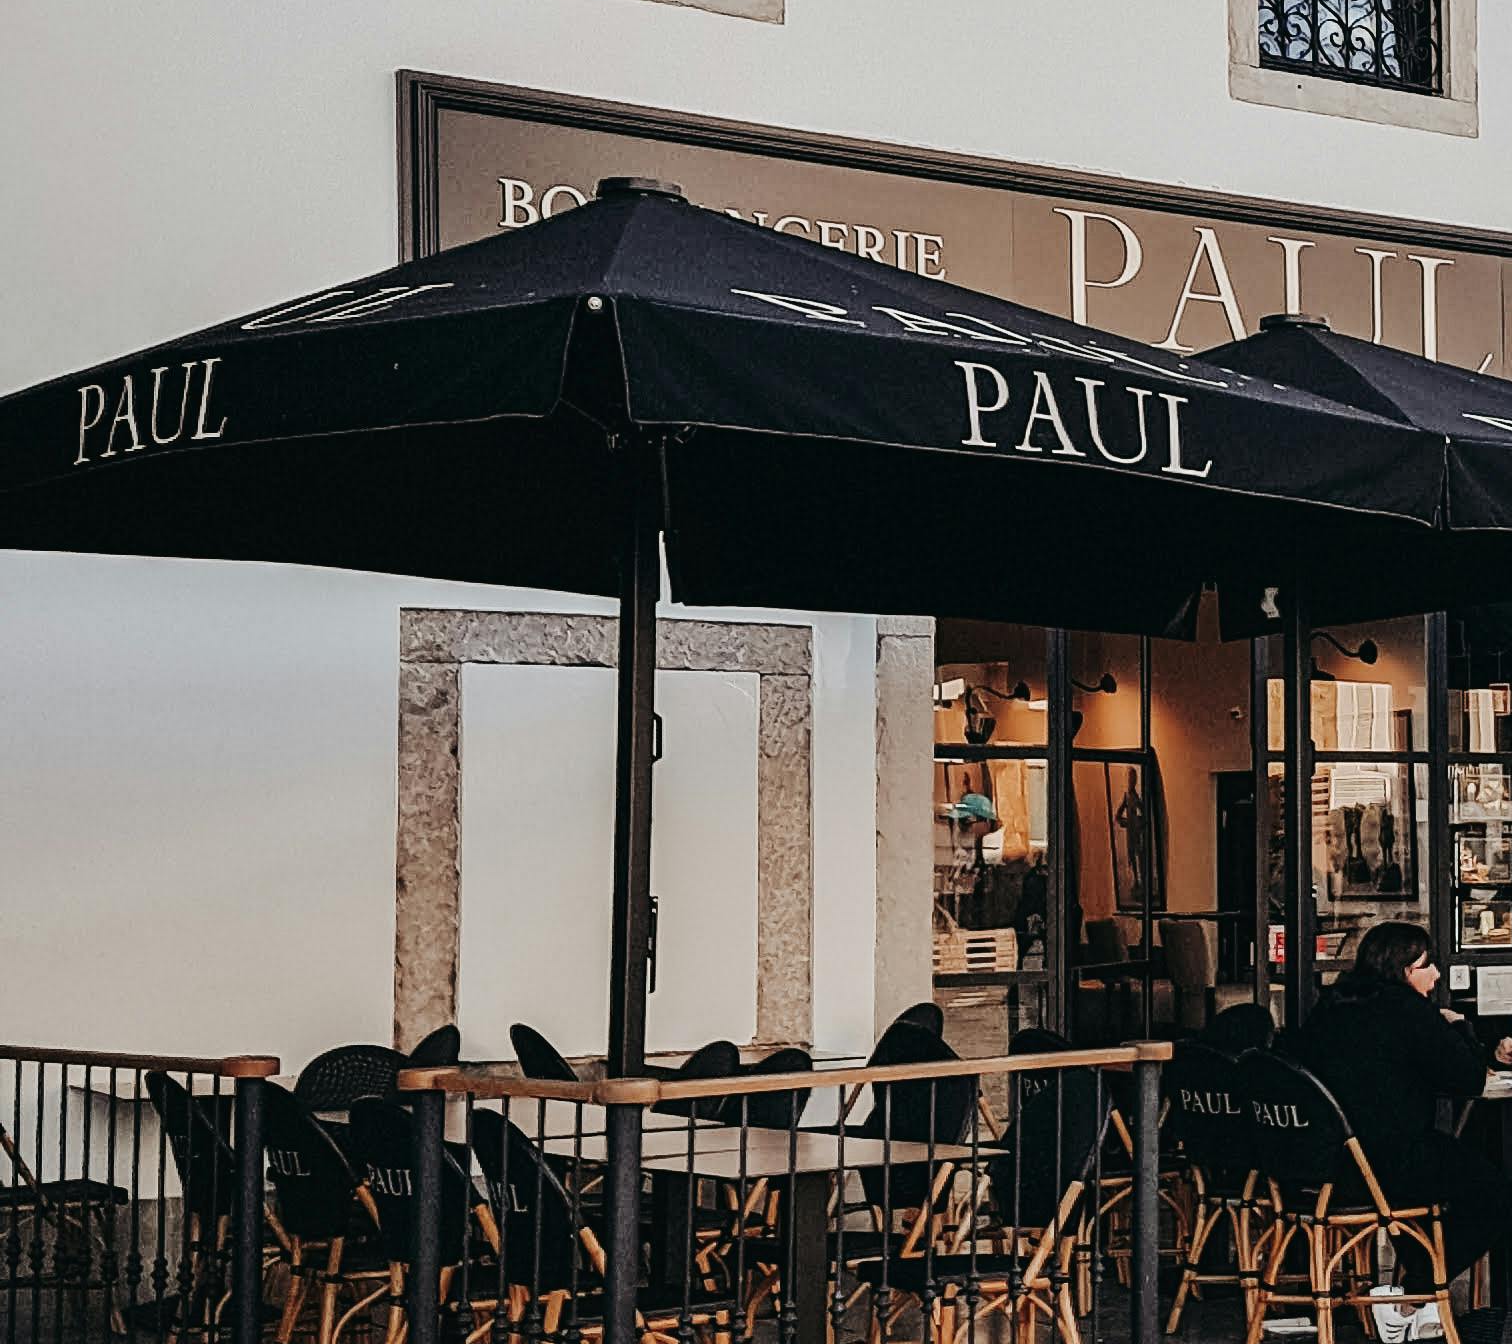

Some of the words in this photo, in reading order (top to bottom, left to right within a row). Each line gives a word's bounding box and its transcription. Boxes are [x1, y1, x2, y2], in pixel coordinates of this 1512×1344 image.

[498, 177, 947, 282] BOERIE
[73, 357, 229, 466] PAUL
[953, 360, 1214, 479] PAUL
[1179, 1088, 1242, 1116] PAUL
[1251, 1099, 1310, 1129] PAUL
